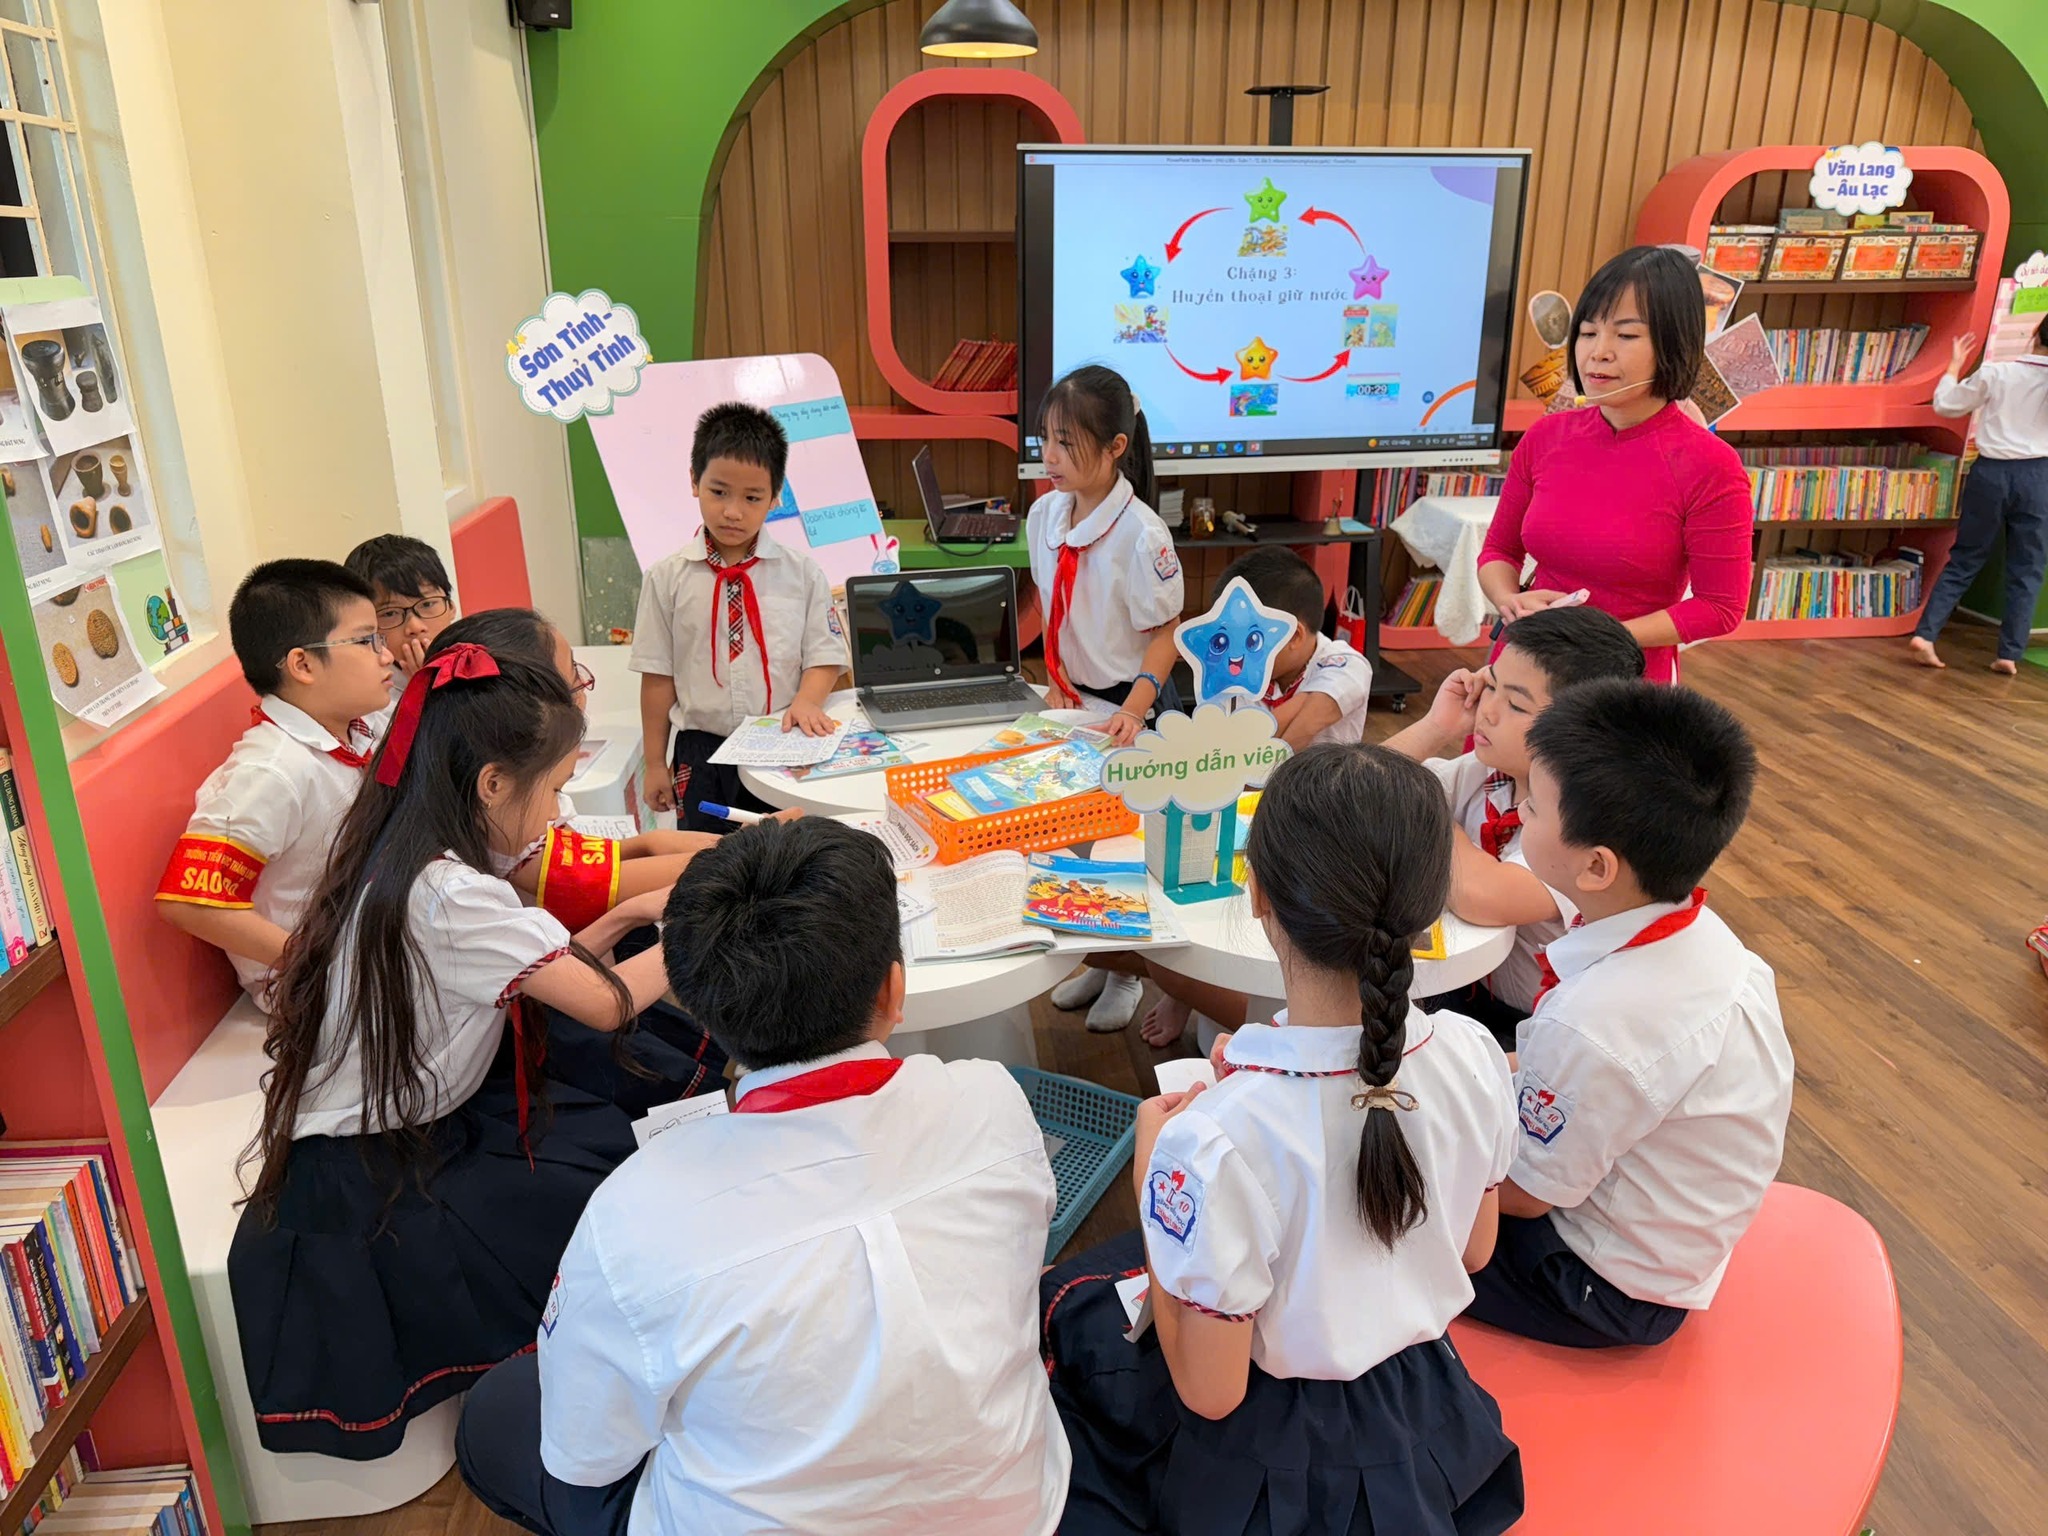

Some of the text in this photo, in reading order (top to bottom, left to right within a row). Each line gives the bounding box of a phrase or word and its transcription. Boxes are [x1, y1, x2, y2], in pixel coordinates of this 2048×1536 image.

[1828, 160, 1895, 178] Văn Lang
[1862, 183, 1888, 200] Lạc
[1227, 266, 1297, 281] Chặng 3:
[1172, 288, 1348, 305] Huyền thoại giữ nước
[519, 342, 564, 378] Sơn
[587, 333, 636, 372] Tinh
[1358, 384, 1387, 395] 00:29
[1107, 746, 1288, 783] Hướng dẫn viên
[180, 866, 222, 894] SAO
[1038, 904, 1068, 916] Sơn
[1547, 1113, 1559, 1123] 10
[1179, 1201, 1190, 1213] 10
